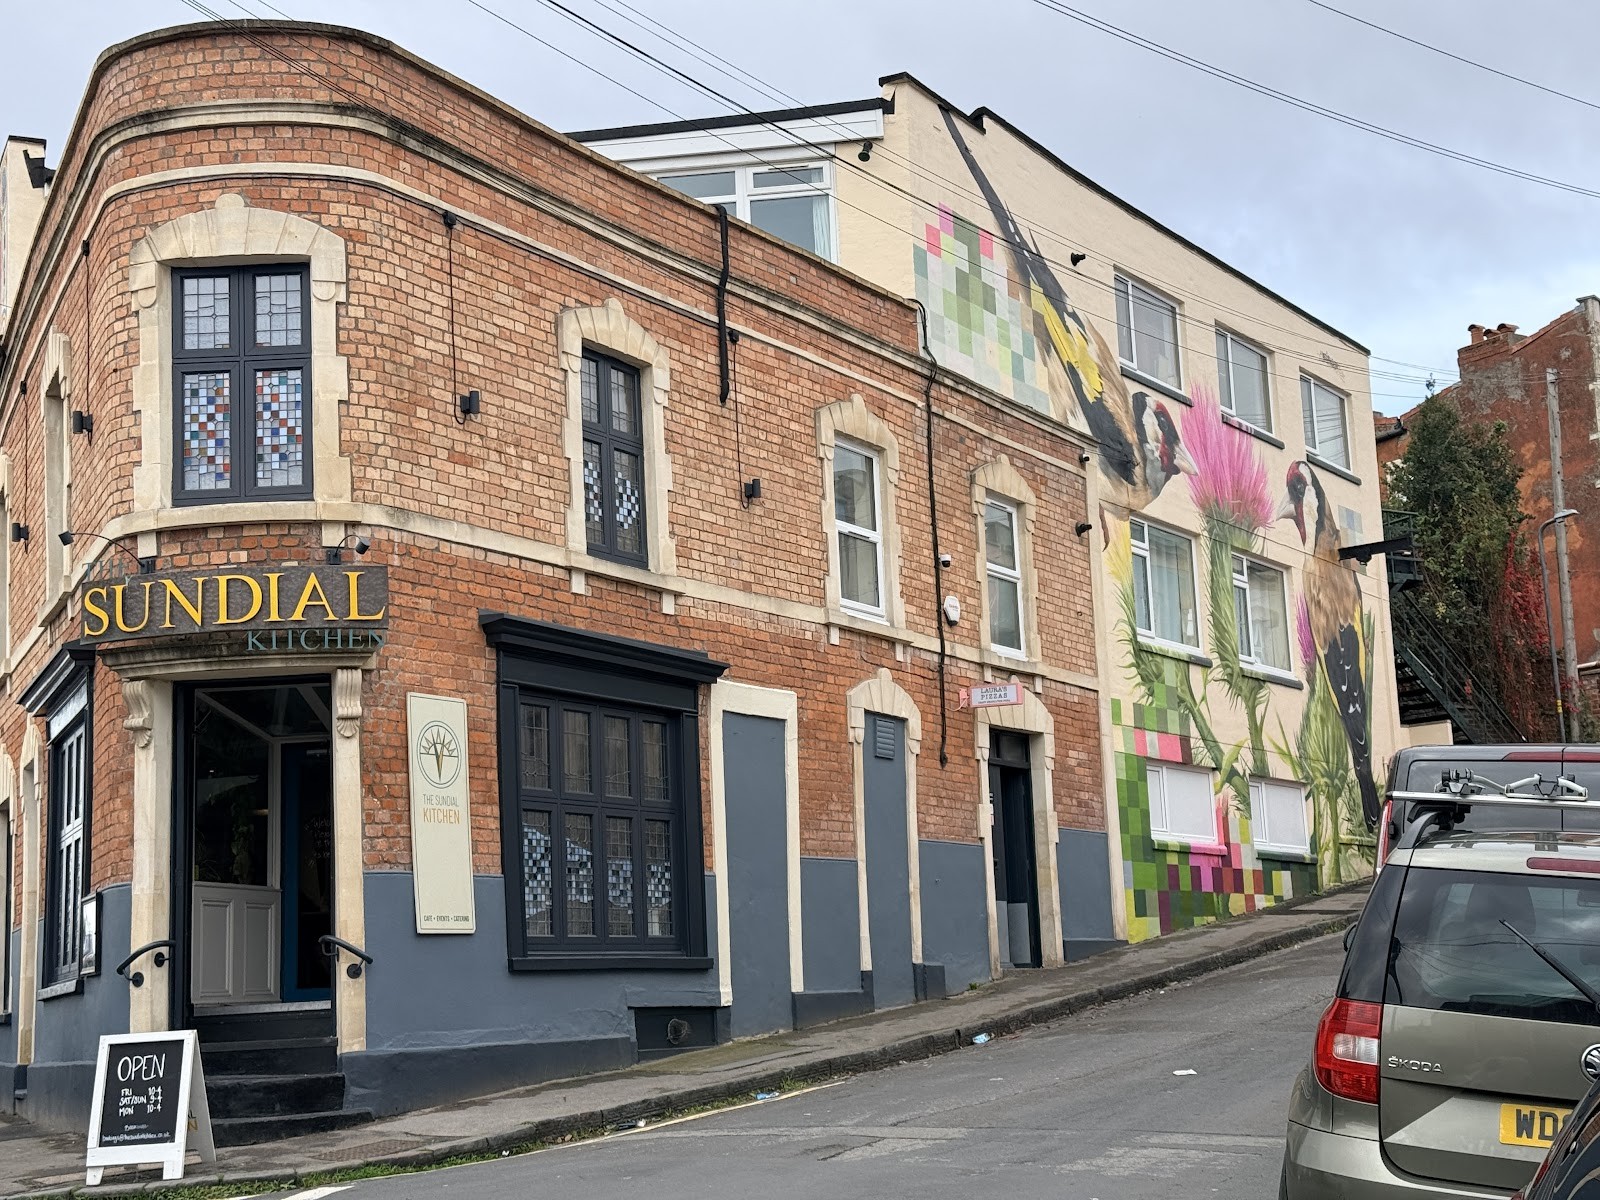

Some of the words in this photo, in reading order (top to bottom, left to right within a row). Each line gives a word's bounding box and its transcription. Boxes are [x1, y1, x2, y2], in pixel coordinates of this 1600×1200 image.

[84, 571, 386, 637] SUNDIAL
[246, 628, 385, 651] KITCHEN
[423, 793, 434, 805] THE
[435, 794, 460, 807] SUNDIAL
[422, 807, 460, 824] KITCHEN
[117, 1053, 166, 1082] OPEN
[1388, 1055, 1445, 1074] ŠKODA
[121, 1088, 133, 1096] FRI
[148, 1086, 162, 1096] 10-4
[119, 1095, 147, 1106] SAT/SUN
[119, 1106, 134, 1117] MON
[147, 1103, 162, 1114] 10-4
[1515, 1108, 1573, 1141] WD
